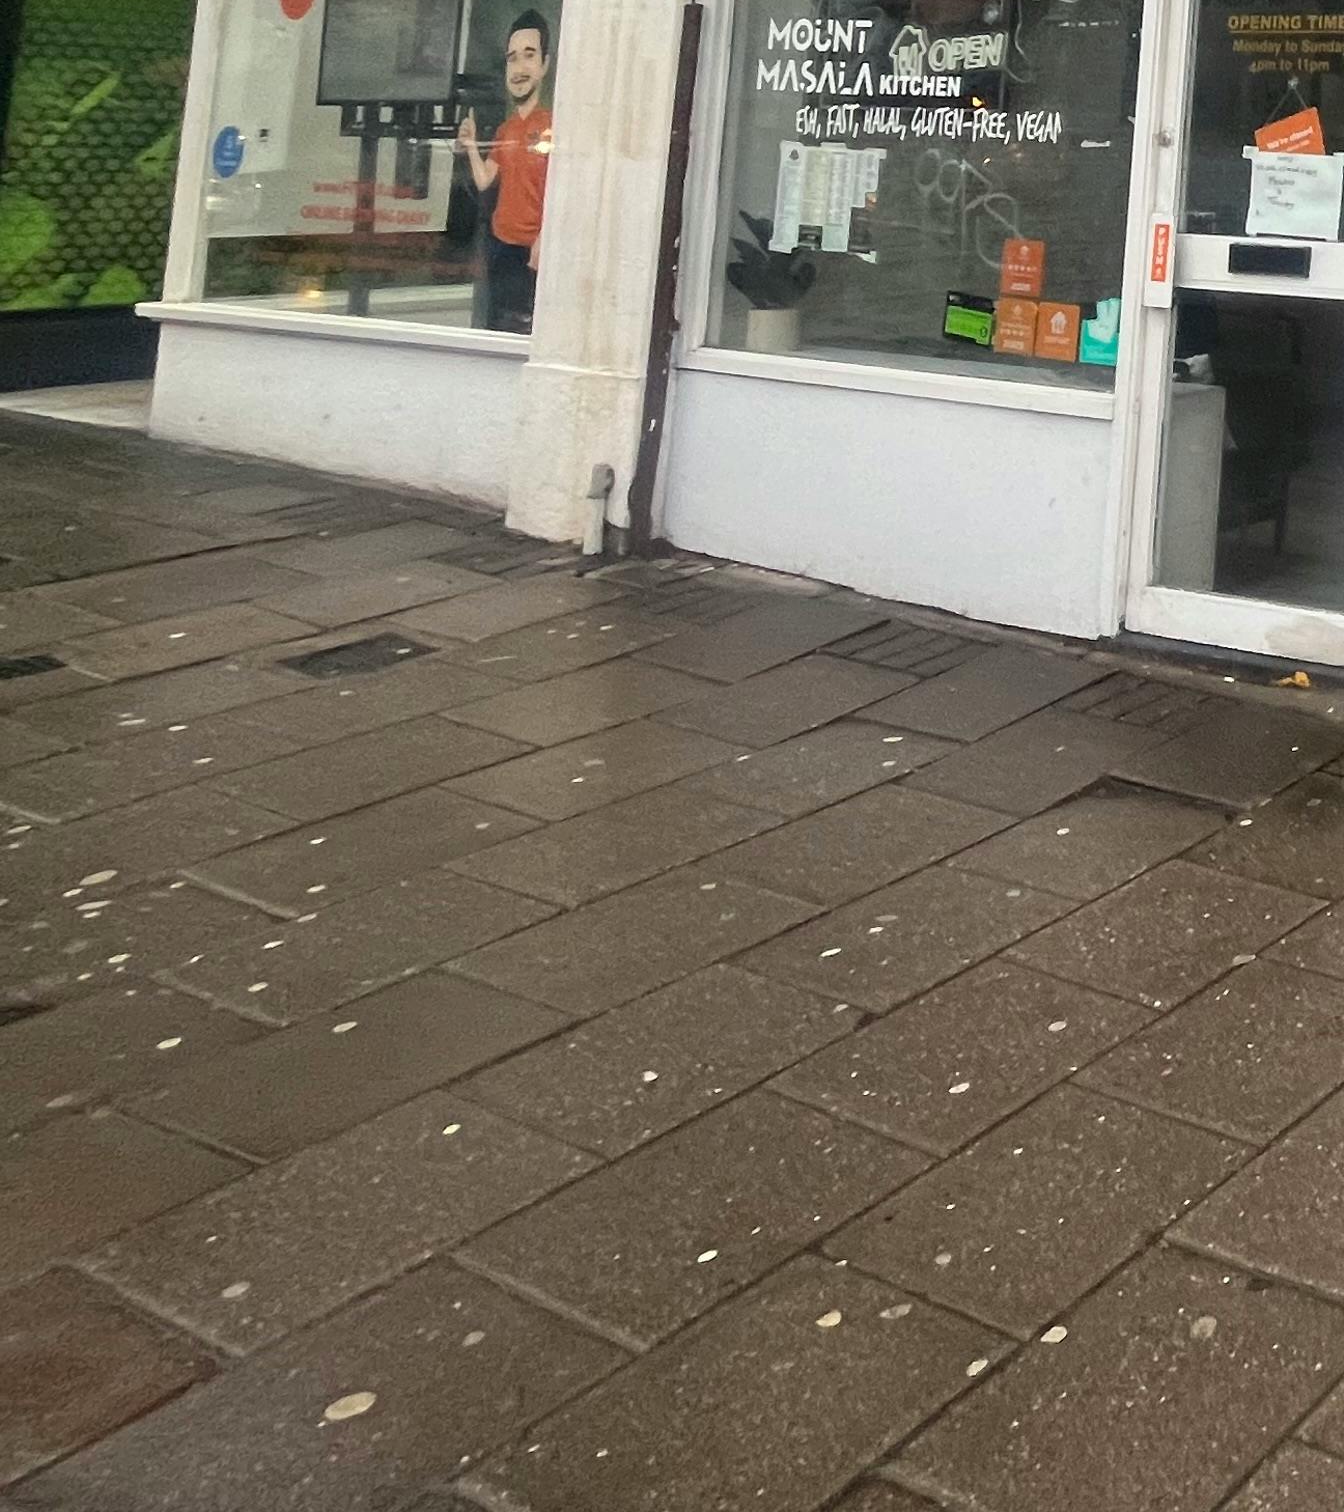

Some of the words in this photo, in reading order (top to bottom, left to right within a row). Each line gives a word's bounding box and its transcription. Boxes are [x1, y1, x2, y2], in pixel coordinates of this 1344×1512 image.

[767, 17, 873, 54] MOUNT
[1227, 14, 1302, 30] OPENING
[928, 31, 1009, 72] OPEN
[1232, 39, 1282, 56] Monday
[1285, 40, 1298, 53] to
[1280, 58, 1293, 71] to
[1297, 58, 1330, 74] 11pm
[756, 58, 873, 96] MASALA
[879, 74, 962, 97] KITCHEN
[911, 106, 1011, 145] GLUTEN-FREE,
